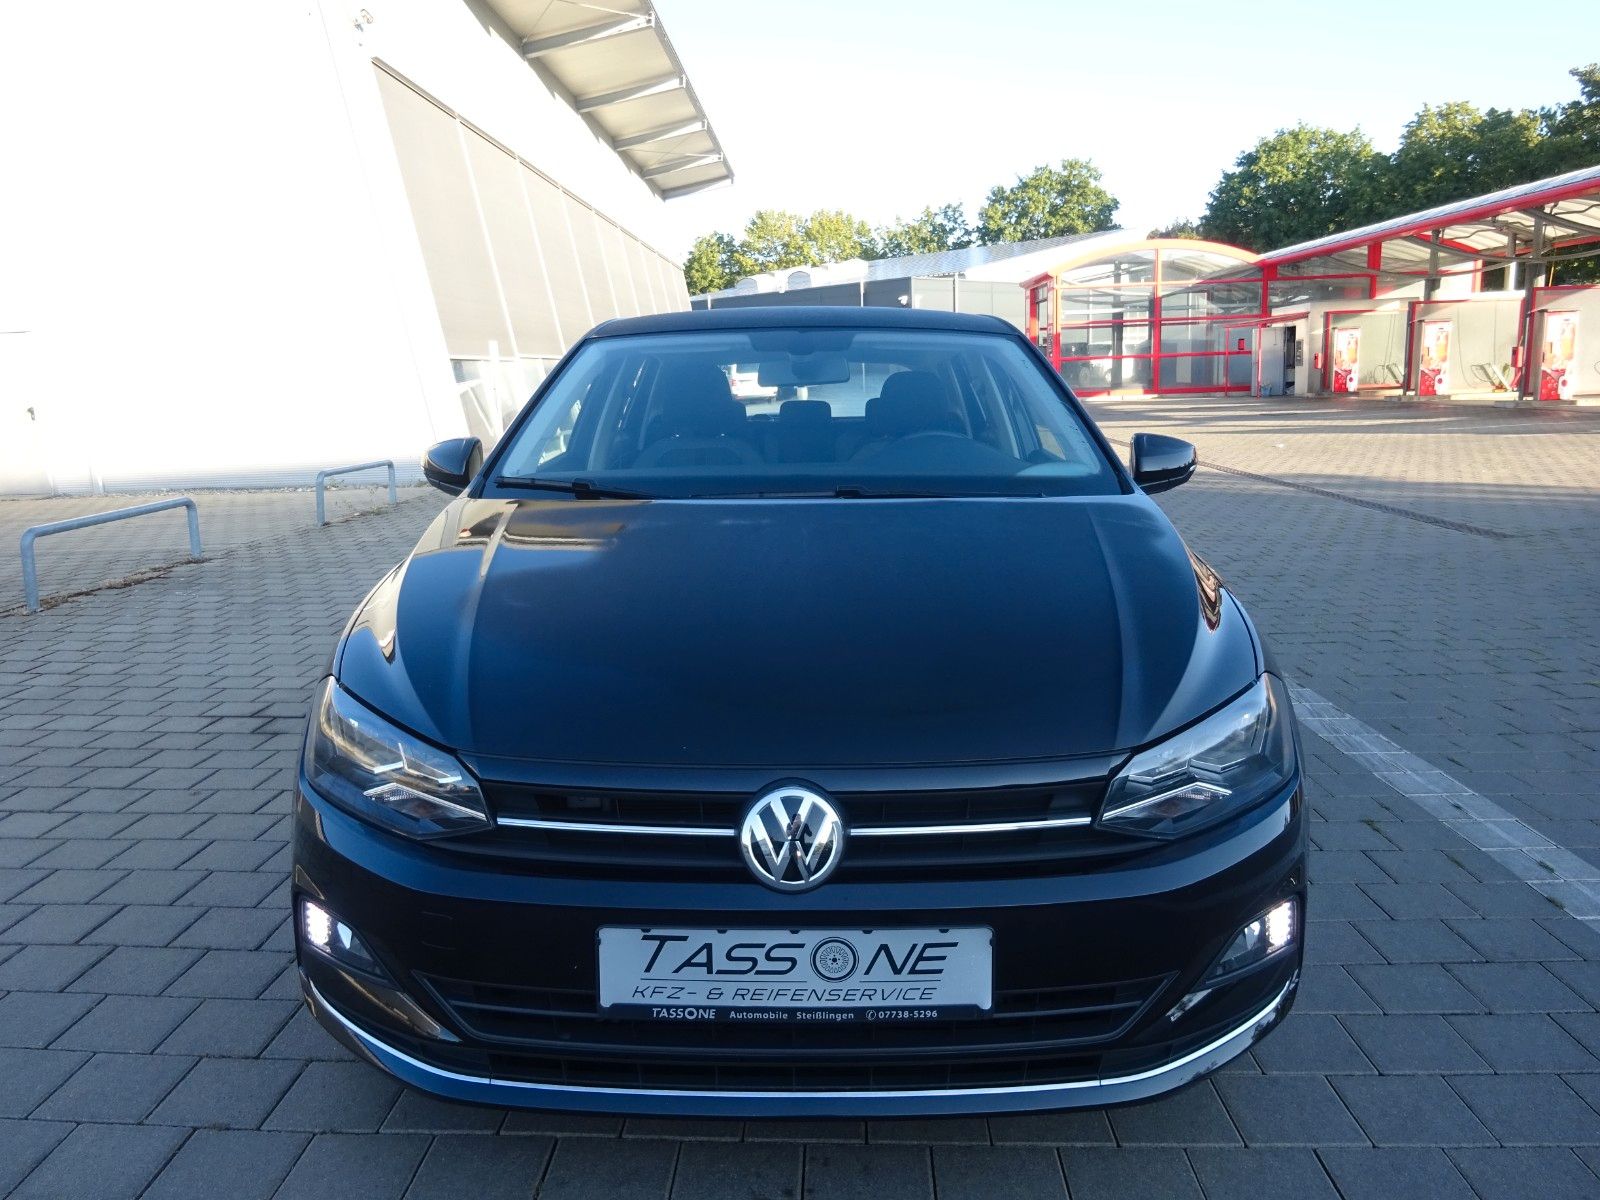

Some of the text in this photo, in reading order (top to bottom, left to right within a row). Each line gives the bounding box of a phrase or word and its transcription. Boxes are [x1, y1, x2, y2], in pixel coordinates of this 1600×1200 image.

[744, 790, 841, 886] VW
[640, 934, 959, 983] TASSONE
[632, 985, 938, 1002] KFZ- & REIFENSERVICE
[652, 1007, 938, 1020] TASSONE Automobile Steißlingen 07738-5296
